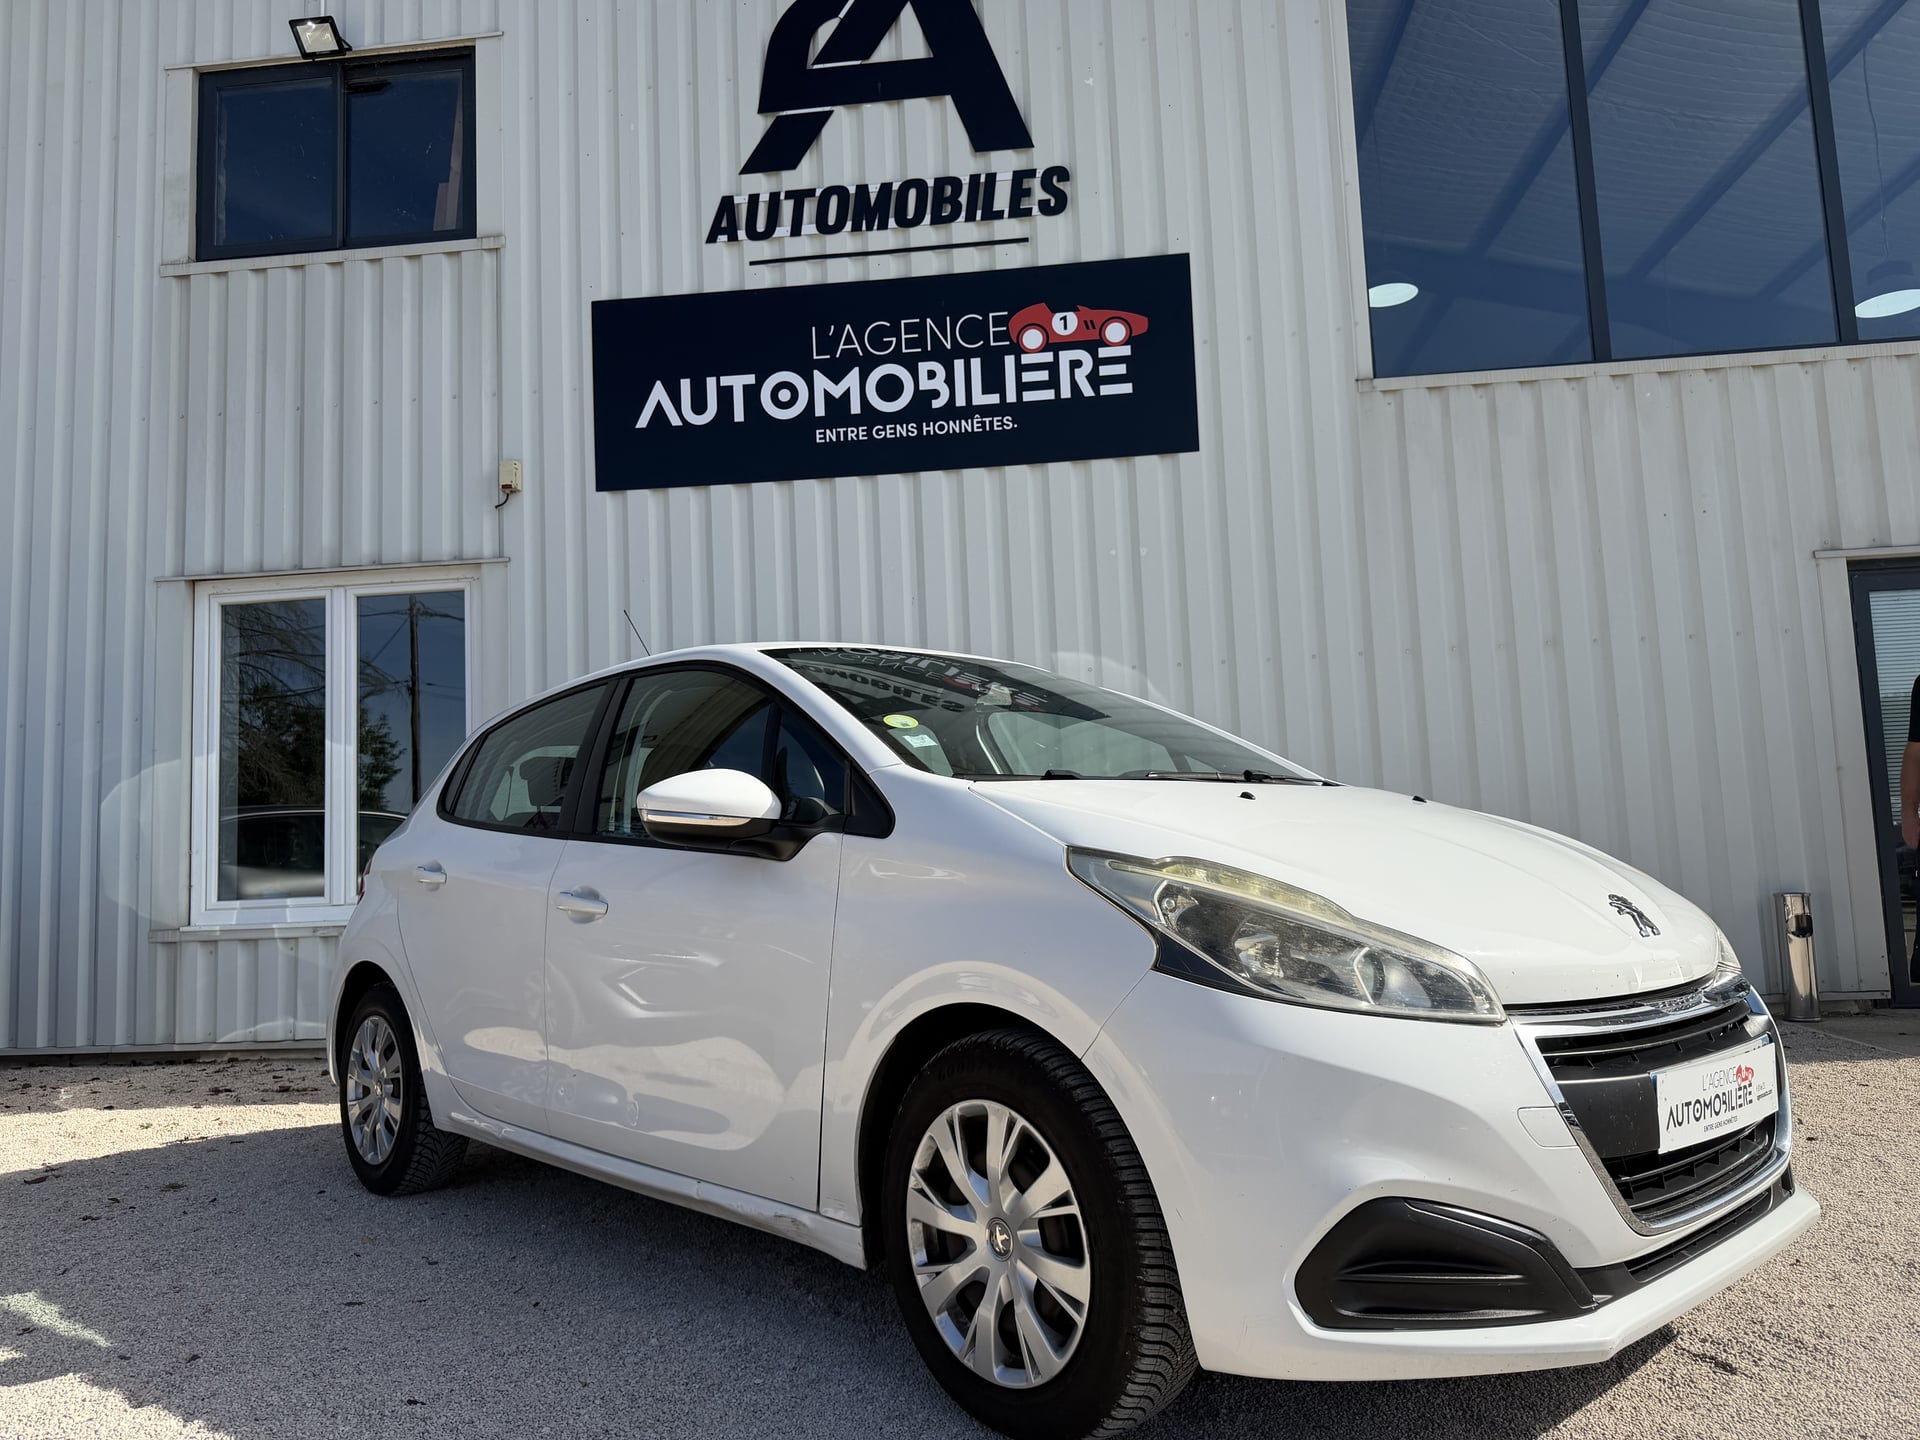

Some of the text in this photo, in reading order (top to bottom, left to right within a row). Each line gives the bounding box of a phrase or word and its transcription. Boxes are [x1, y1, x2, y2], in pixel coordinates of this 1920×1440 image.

[706, 166, 1070, 244] AUTOMOBILES
[812, 311, 1010, 360] L'AGENCE
[815, 414, 1018, 443] ENTRE GENS HONNÊTES.
